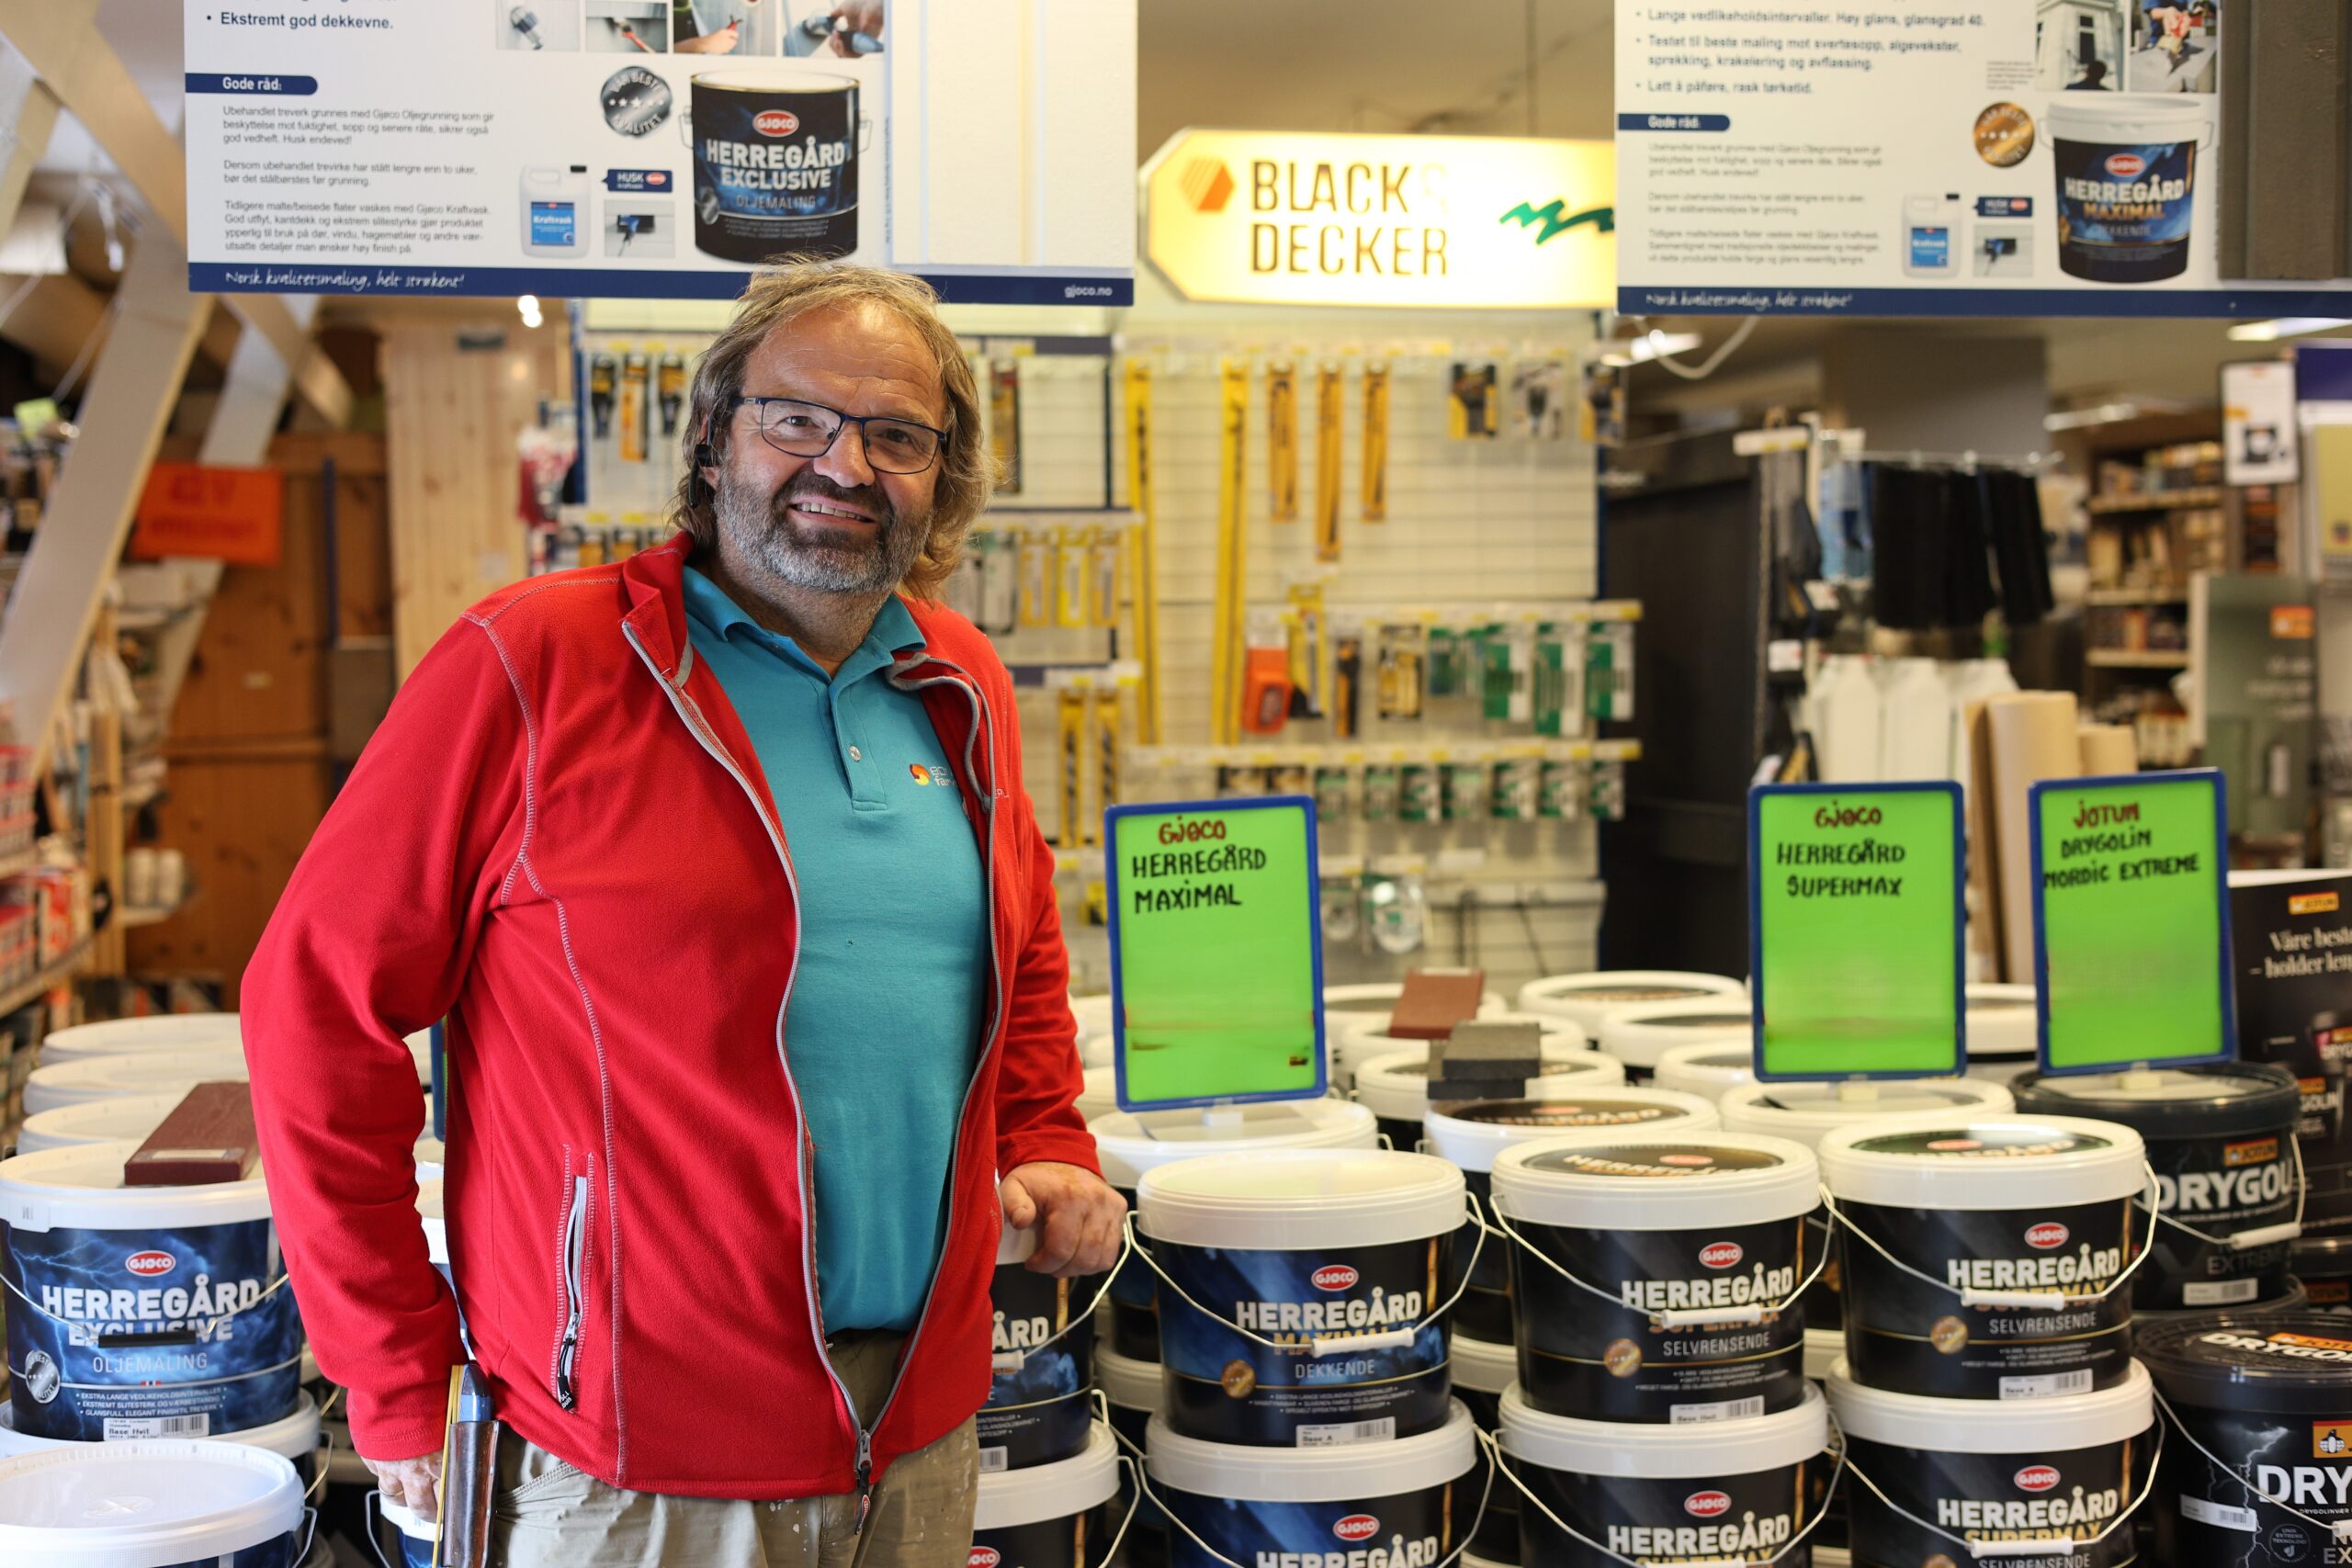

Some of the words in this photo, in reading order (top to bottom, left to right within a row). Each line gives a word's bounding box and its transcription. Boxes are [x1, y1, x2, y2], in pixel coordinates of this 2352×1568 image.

[220, 11, 286, 27] Ekstremt
[289, 14, 317, 29] god
[322, 15, 393, 29] dekkevne.
[221, 76, 254, 90] Gode
[257, 77, 282, 91] råd:
[706, 135, 845, 169] HERREGÅRD
[616, 172, 643, 183] HUSK
[719, 167, 831, 191] EXCLUSIVE
[1250, 160, 1411, 215] BLACK
[2064, 174, 2185, 203] HERREGÅRD
[736, 194, 816, 209] OLJEMALING
[2083, 203, 2165, 221] MAXIMAL
[1250, 222, 1449, 276] DECKER
[225, 267, 263, 285] Norsk
[1132, 844, 1267, 877] HERREGÅRD
[1777, 838, 1906, 865] HERREGÅRD
[1787, 874, 1903, 897] SUPERMAX
[2269, 928, 2312, 952] Våre
[2264, 953, 2324, 979] holder
[130, 1257, 173, 1270] GJØCO
[1702, 1247, 1740, 1262] GJØCO
[1947, 1243, 2120, 1289] HERREGÅRD
[1315, 1269, 1356, 1285] GJØCO
[1622, 1262, 1794, 1310] HERREGÅRD
[41, 1273, 260, 1323] HERREGÅRD
[1236, 1286, 1422, 1331] HERREGÅRD
[1988, 1311, 2098, 1335] SELVRENSENDE
[1663, 1331, 1771, 1358] SELVRENSENDE
[93, 1352, 208, 1374] OLJEMALING
[1295, 1359, 1376, 1380] DEKKENDE
[1689, 1495, 1728, 1510] GJØCO
[1937, 1485, 2119, 1529] HERREGÅRD
[1337, 1519, 1376, 1534] GJØCO
[1607, 1511, 1792, 1555] HERREGÅRD
